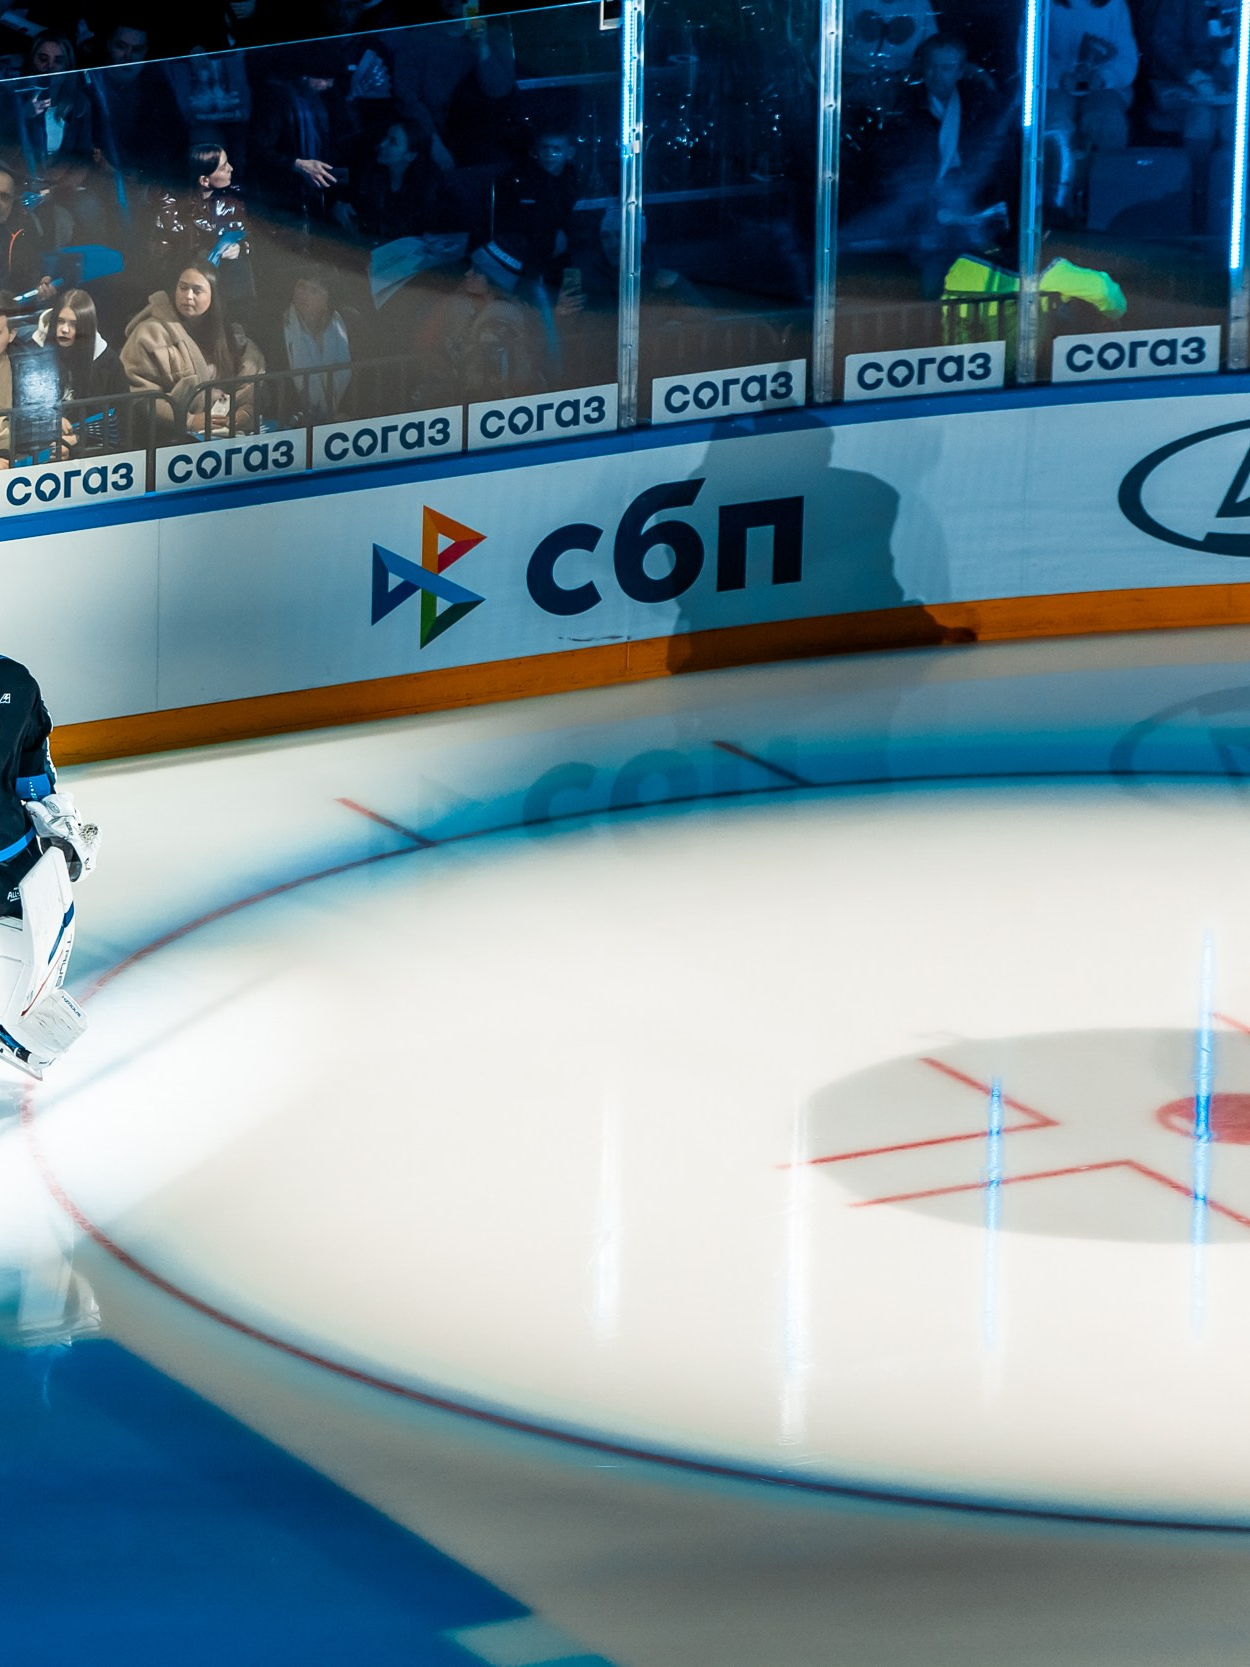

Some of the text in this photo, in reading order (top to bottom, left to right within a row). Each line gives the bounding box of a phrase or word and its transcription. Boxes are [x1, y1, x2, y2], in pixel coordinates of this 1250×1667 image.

[856, 352, 992, 391] согаз
[1066, 336, 1206, 373] согаз
[664, 371, 793, 414] согаз
[324, 416, 450, 461] согаз
[479, 395, 606, 440] согаз
[167, 440, 295, 484] согаз
[5, 463, 134, 506] согаз
[526, 477, 804, 617] сбп
